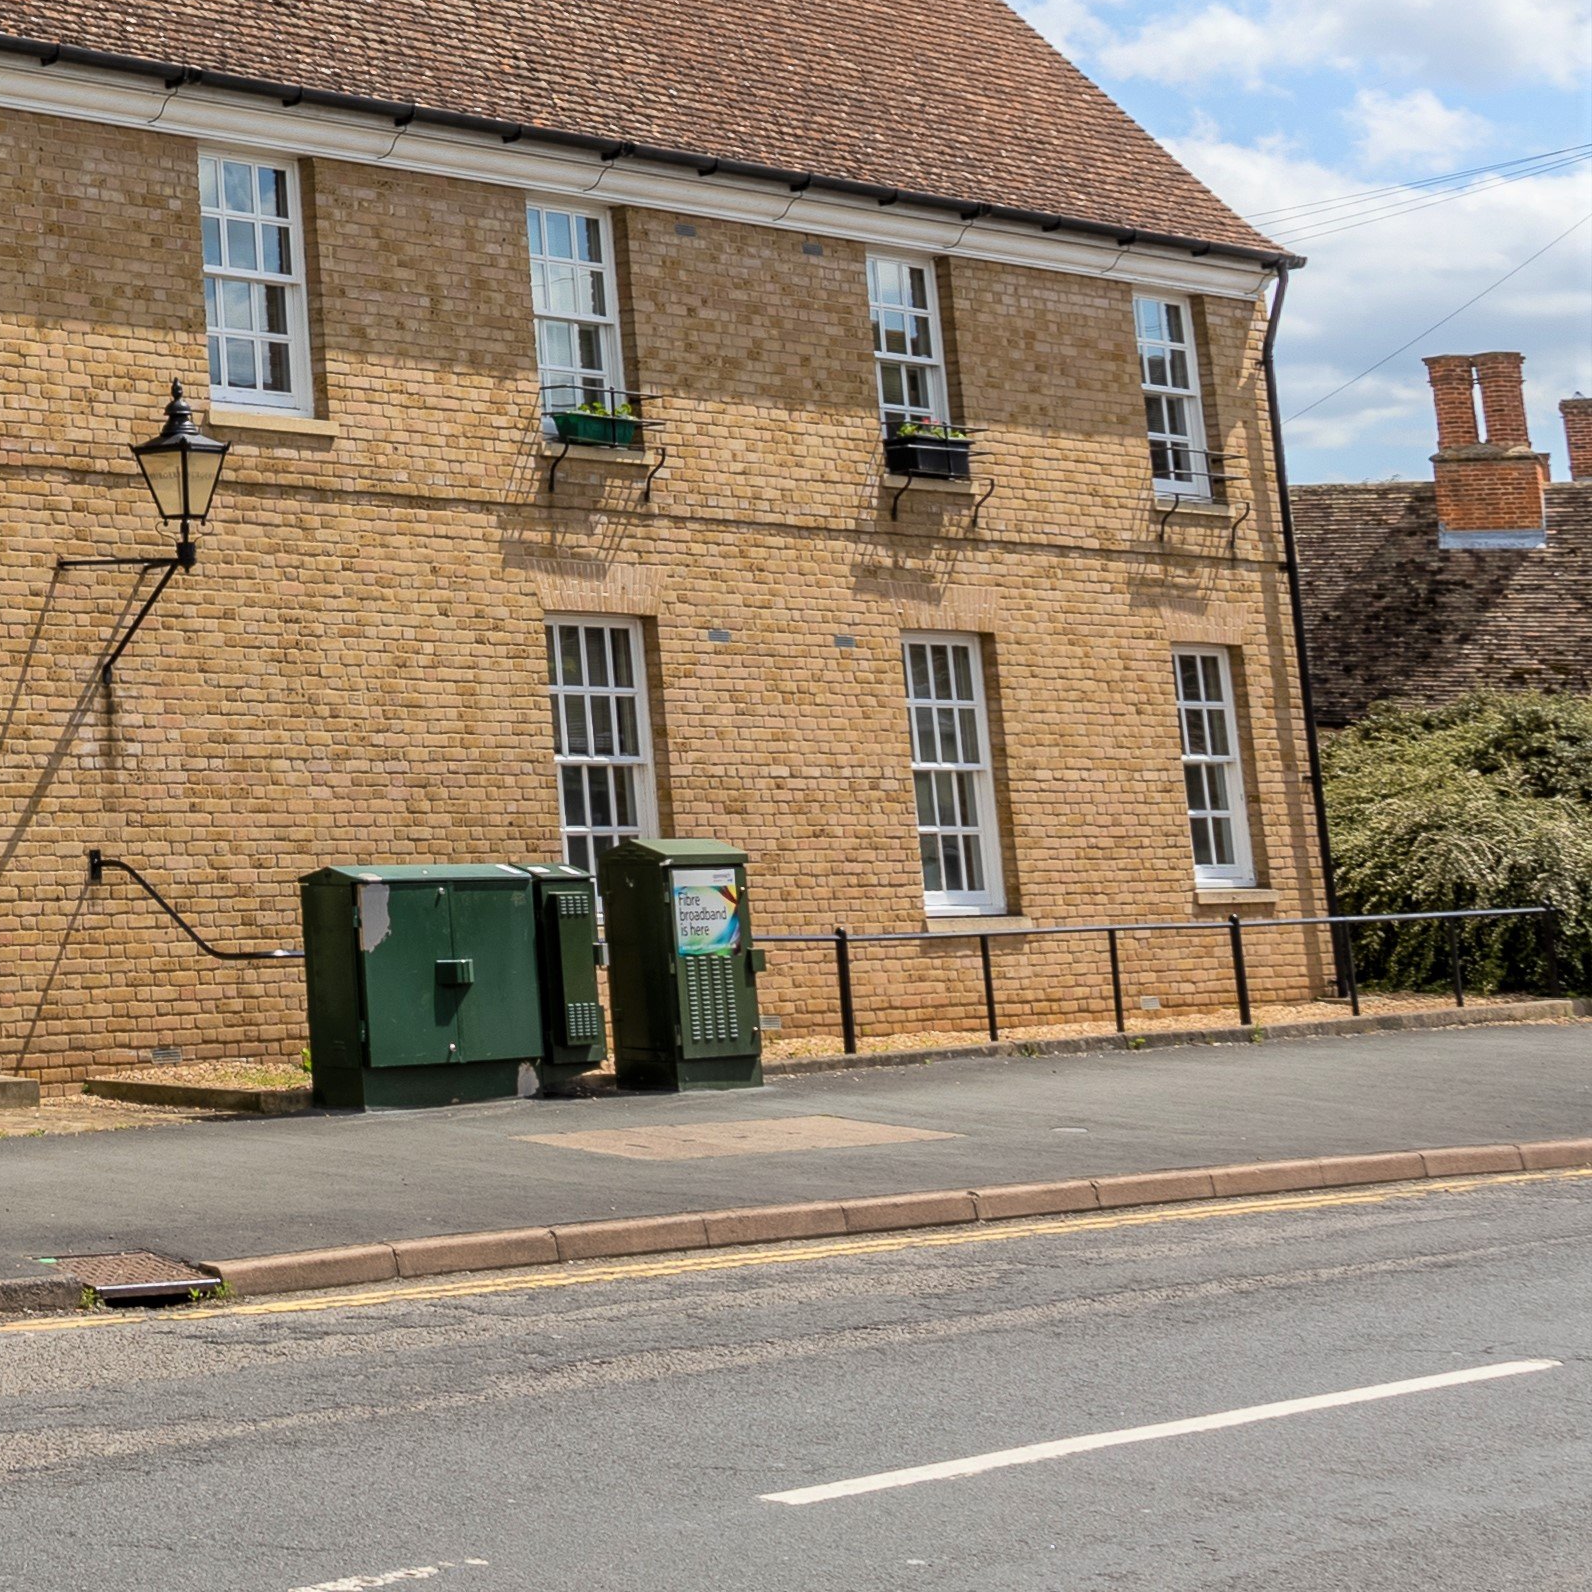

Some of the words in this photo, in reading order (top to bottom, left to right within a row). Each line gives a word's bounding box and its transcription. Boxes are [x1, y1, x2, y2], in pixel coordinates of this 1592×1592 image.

[678, 892, 700, 906] Fibre
[679, 906, 727, 921] broadband
[681, 923, 688, 936] is
[690, 922, 709, 936] here
